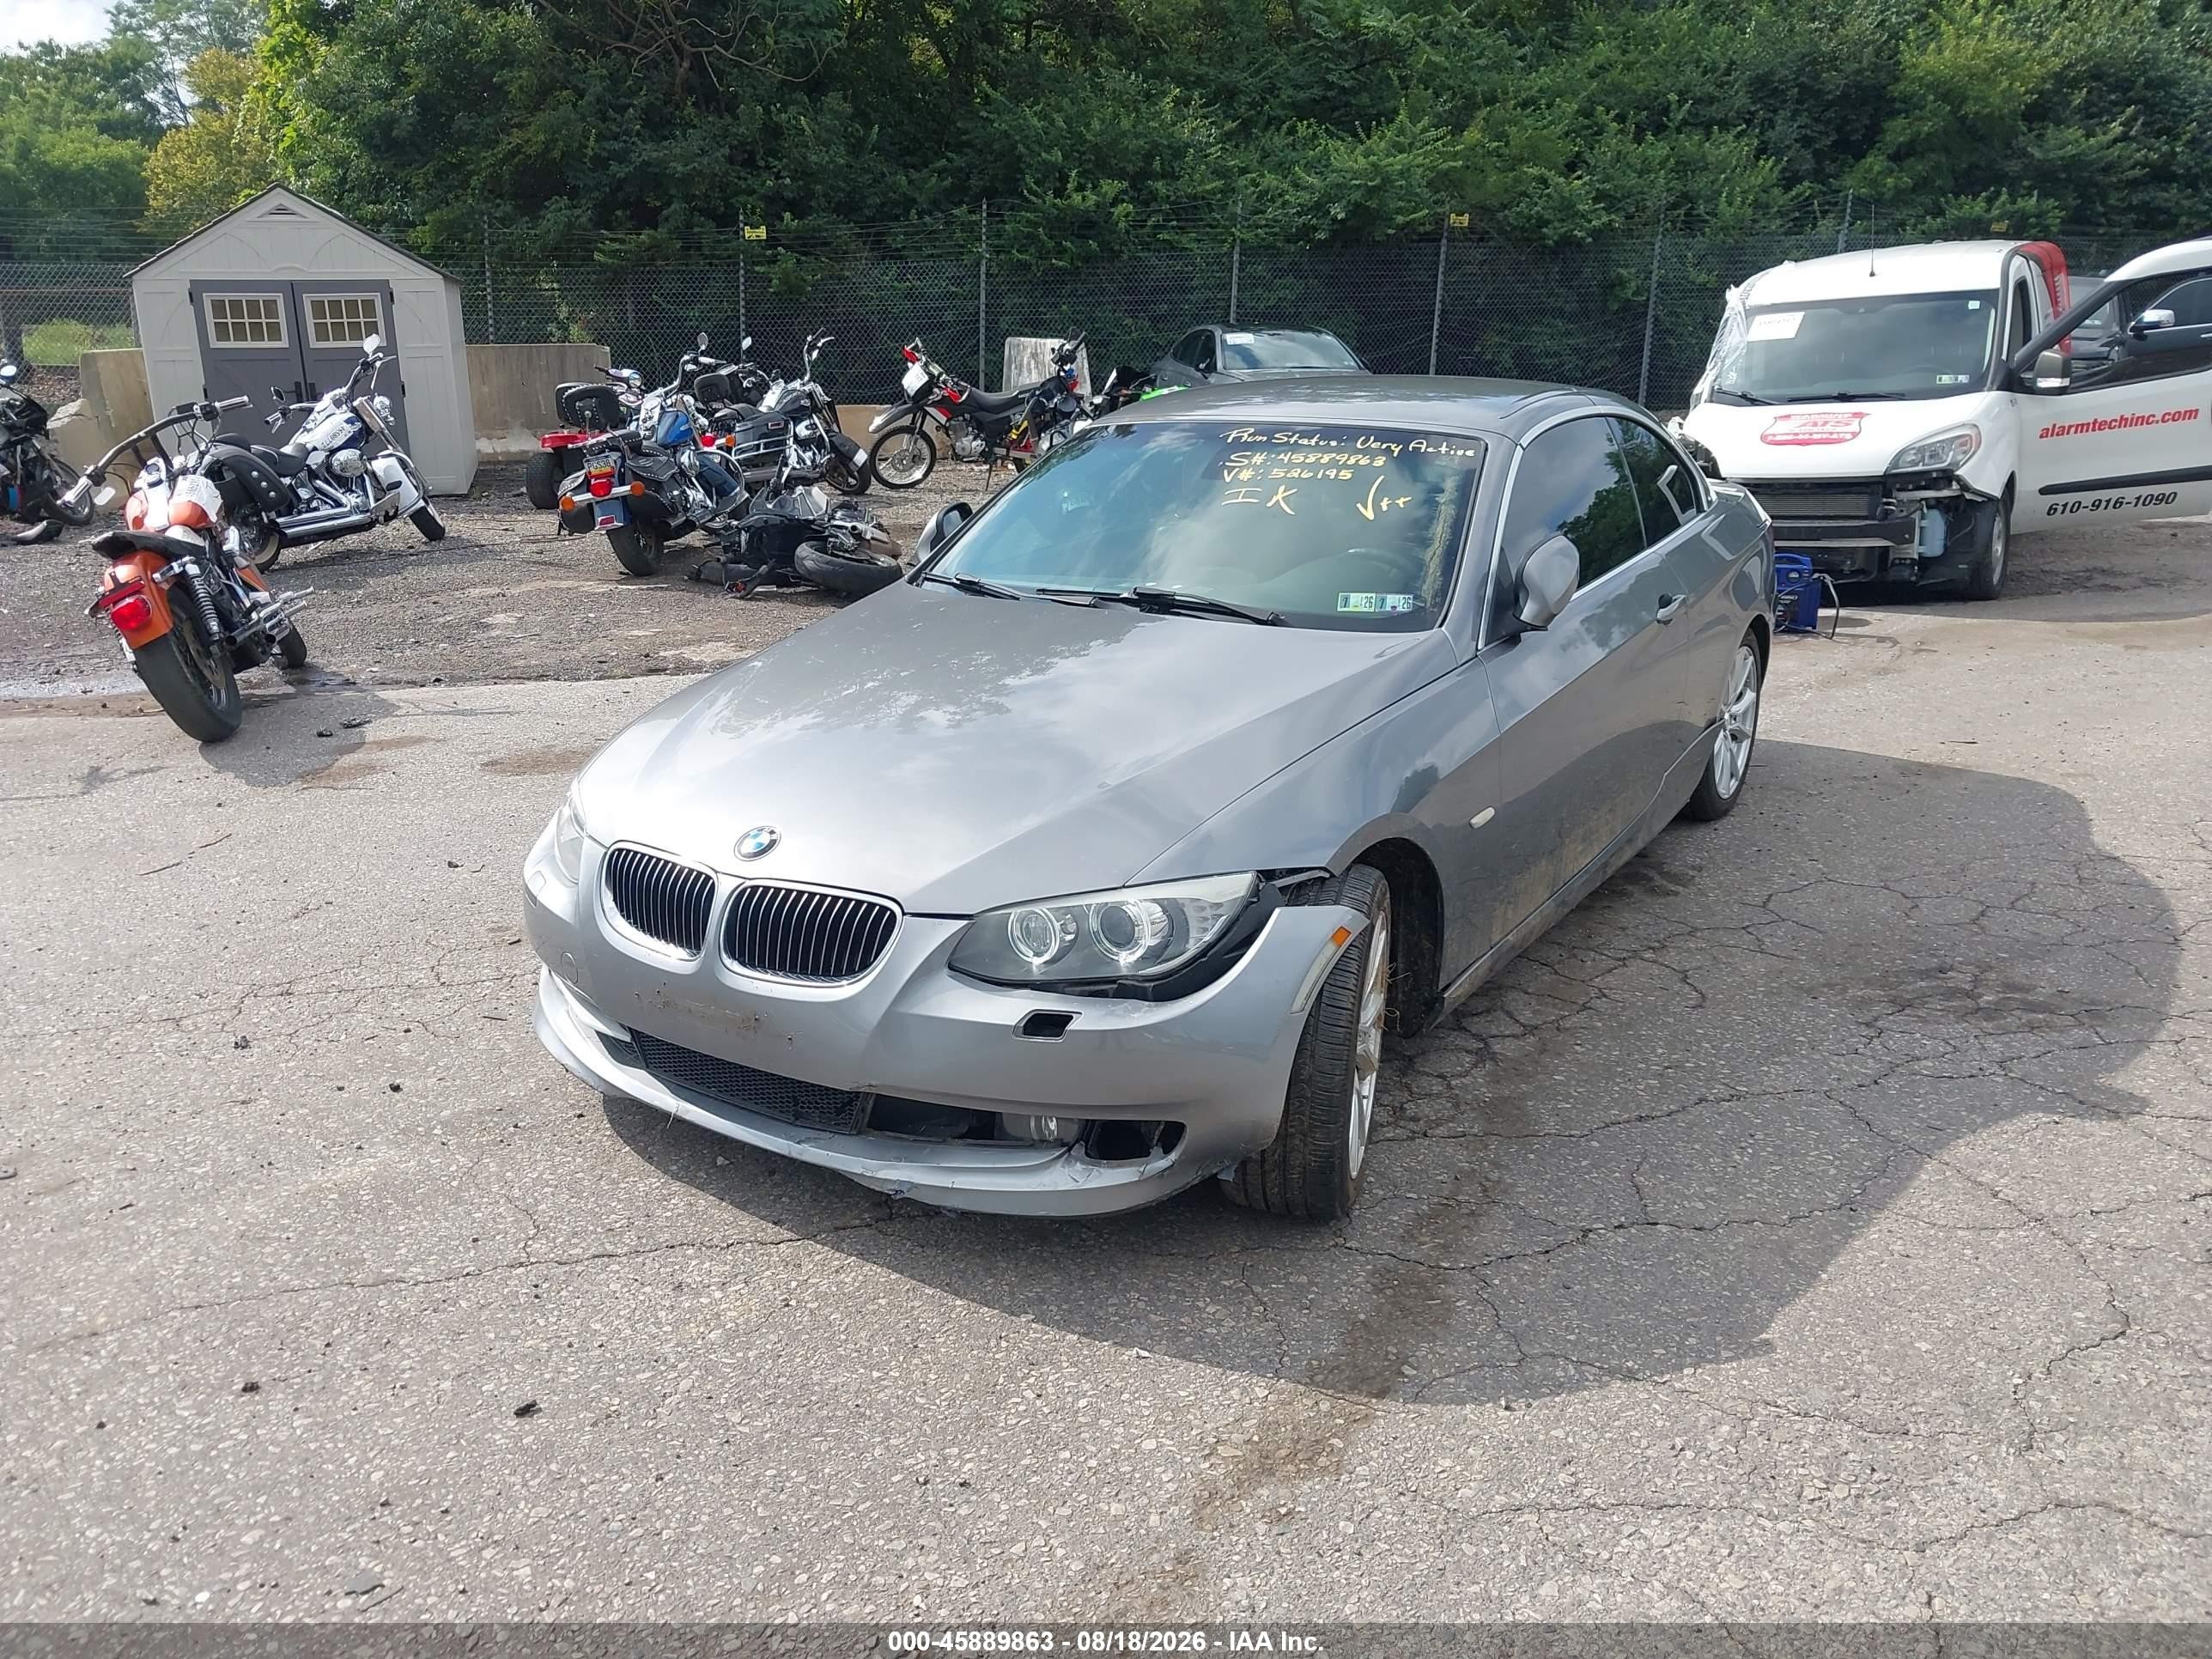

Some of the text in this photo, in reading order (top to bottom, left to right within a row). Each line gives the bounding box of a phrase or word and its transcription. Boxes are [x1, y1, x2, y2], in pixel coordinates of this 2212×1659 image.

[2039, 408, 2200, 439] alarmtechinc.com
[1218, 428, 1268, 444] Run
[1271, 432, 1347, 447] Status:
[1408, 439, 1476, 458] Active
[1267, 468, 1354, 481] 526195
[2046, 491, 2179, 516] 610-916-1090
[1342, 596, 1374, 609] 7 26
[1379, 596, 1412, 610] 7 26
